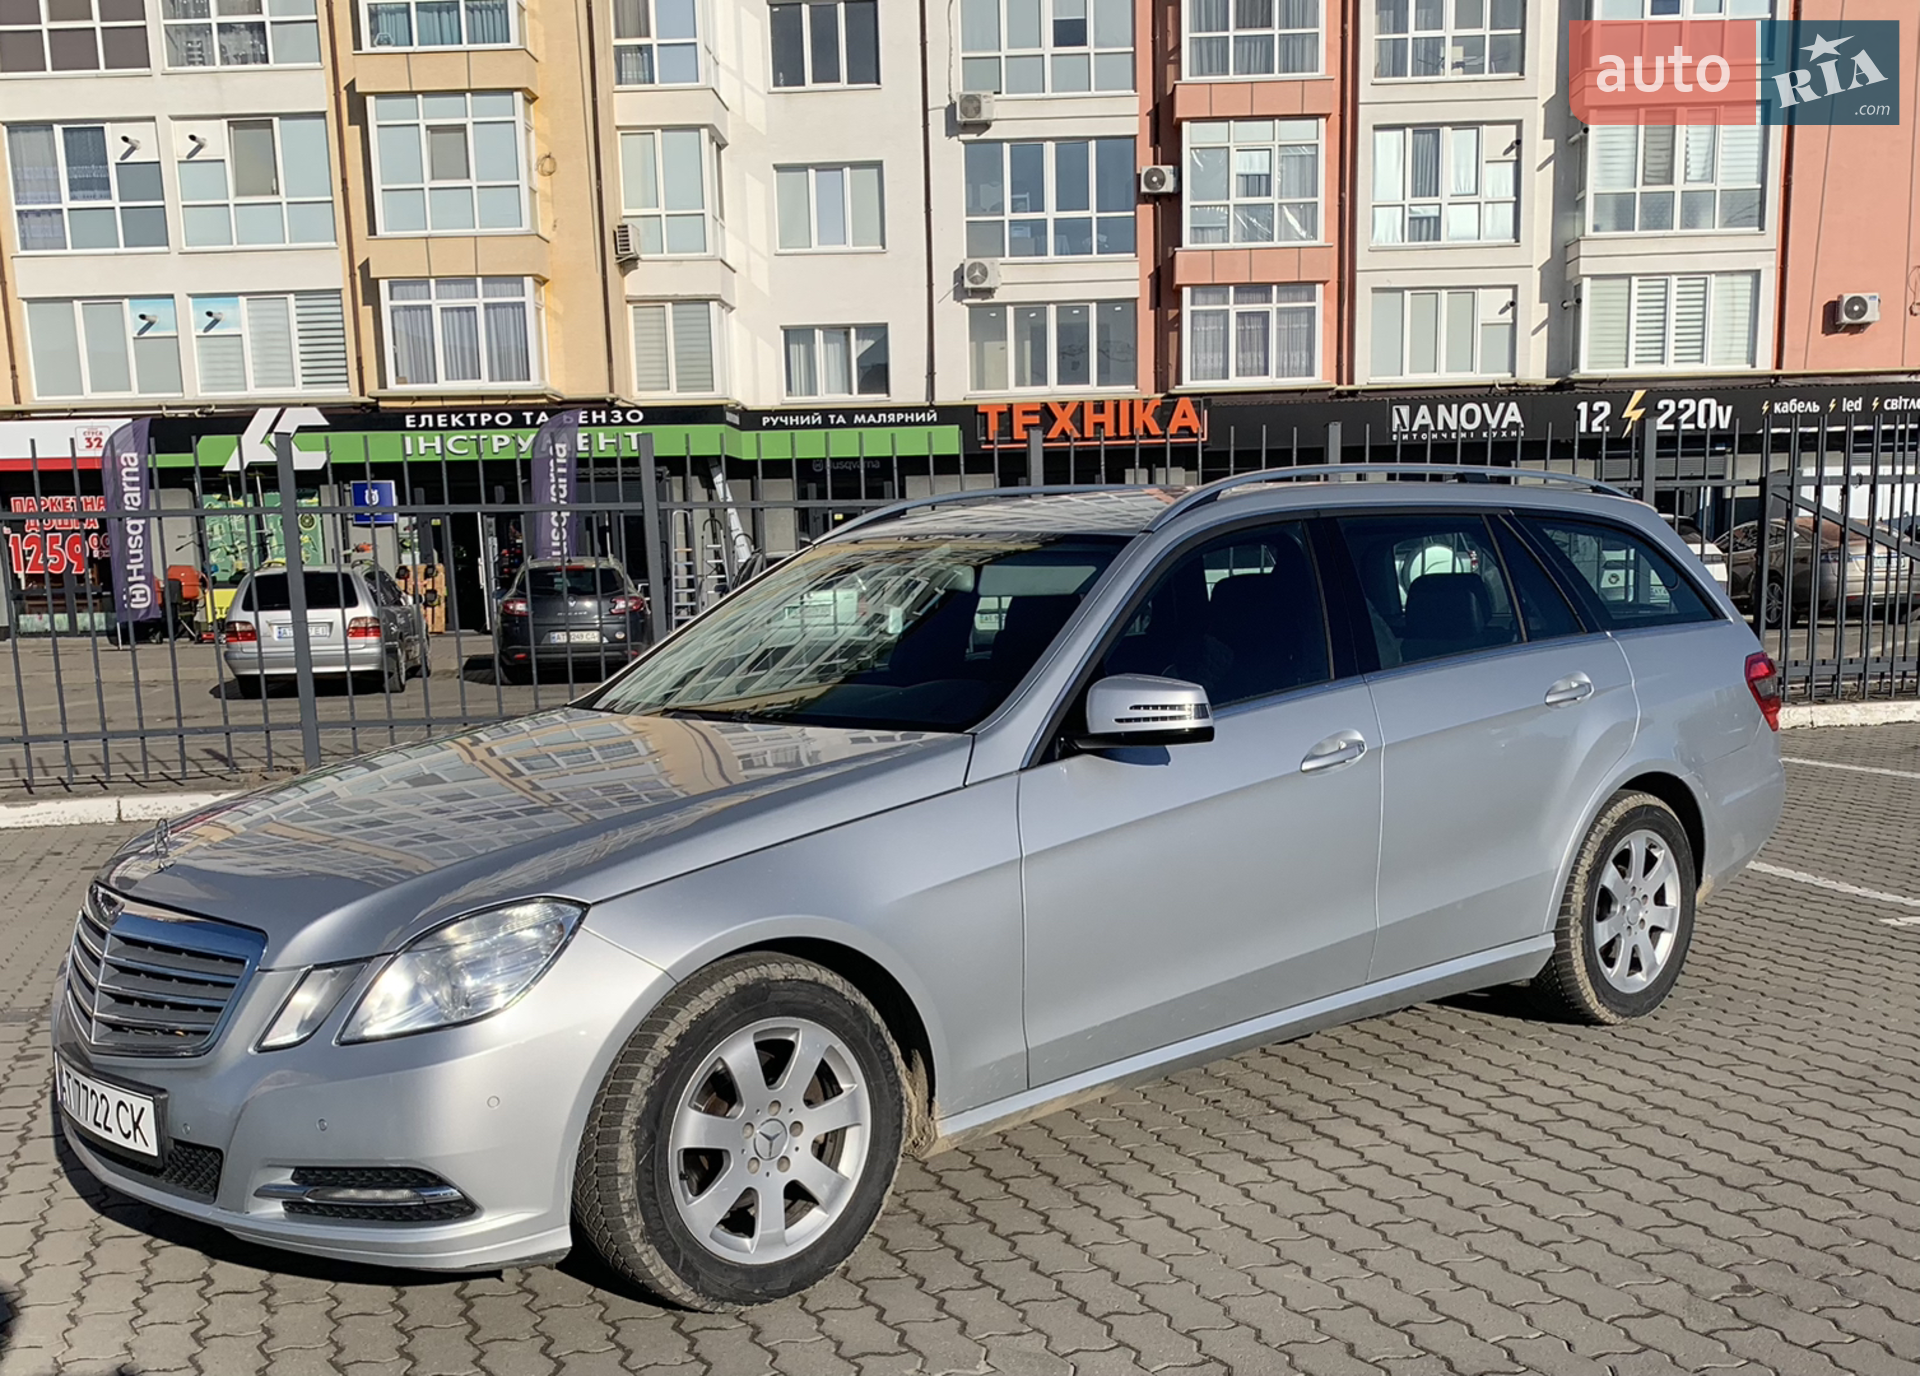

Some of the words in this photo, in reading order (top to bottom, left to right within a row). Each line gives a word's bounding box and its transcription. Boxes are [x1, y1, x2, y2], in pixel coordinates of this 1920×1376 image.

[1774, 398, 1820, 414] кабель
[1842, 397, 1862, 412] led
[405, 412, 512, 428] ЕЛЕКТРО
[522, 411, 549, 425] ТА
[762, 412, 823, 427] РУЧНИЙ
[829, 414, 846, 425] ТА
[853, 410, 938, 425] МАЛЯРНИЙ
[978, 397, 1201, 440] ТЕХНІКА
[1577, 401, 1611, 432] 12
[85, 437, 103, 448] 32
[1483, 430, 1525, 439] КУХНІ
[825, 460, 881, 471] usqvarna
[9, 533, 89, 574] 1259
[74, 1079, 113, 1134] 7722
[116, 1100, 149, 1148] CK
